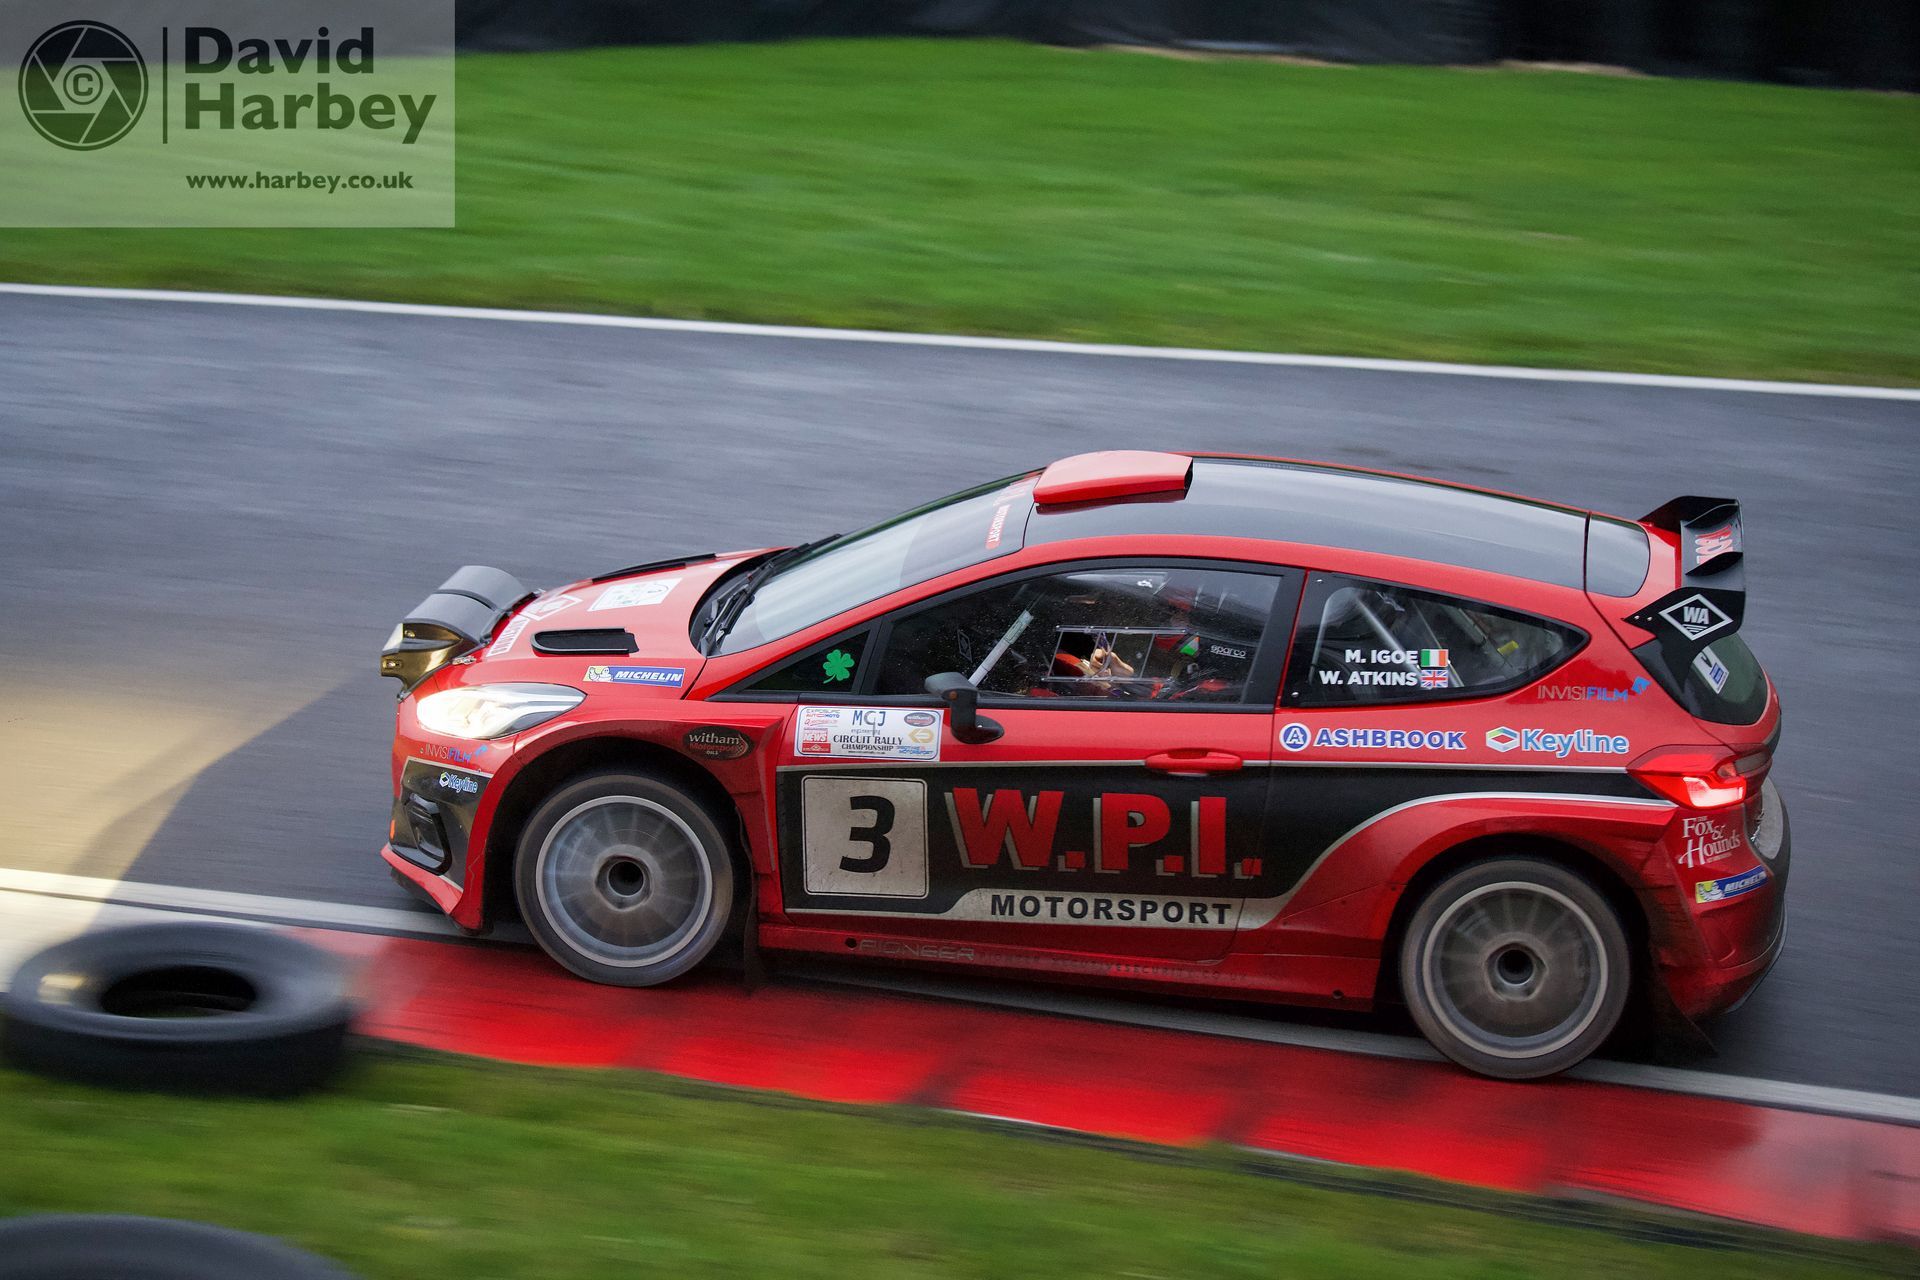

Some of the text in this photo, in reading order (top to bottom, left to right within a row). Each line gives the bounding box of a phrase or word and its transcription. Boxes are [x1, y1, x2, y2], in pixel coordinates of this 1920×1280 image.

[1683, 605, 1709, 625] WA
[1210, 644, 1247, 657] sparco
[1344, 649, 1418, 664] M. IGOE
[613, 670, 683, 682] MICHELIN
[1318, 670, 1418, 687] W. ATKINS
[1537, 684, 1629, 701] INVISIFILM
[688, 732, 740, 745] witham
[833, 734, 903, 746] CIRCUIT RALLY
[841, 743, 894, 752] CHAMPIONSHIP
[1315, 728, 1466, 750] ASHBROOK
[1522, 729, 1629, 758] Keyline
[449, 773, 479, 794] Keyline
[838, 794, 897, 874] 3
[946, 787, 1263, 878] W.P.I.
[1682, 817, 1715, 839] Fox
[1678, 830, 1741, 868] Hounds
[989, 894, 1233, 926] MOTORSPORT
[859, 938, 976, 961] PIONEER
